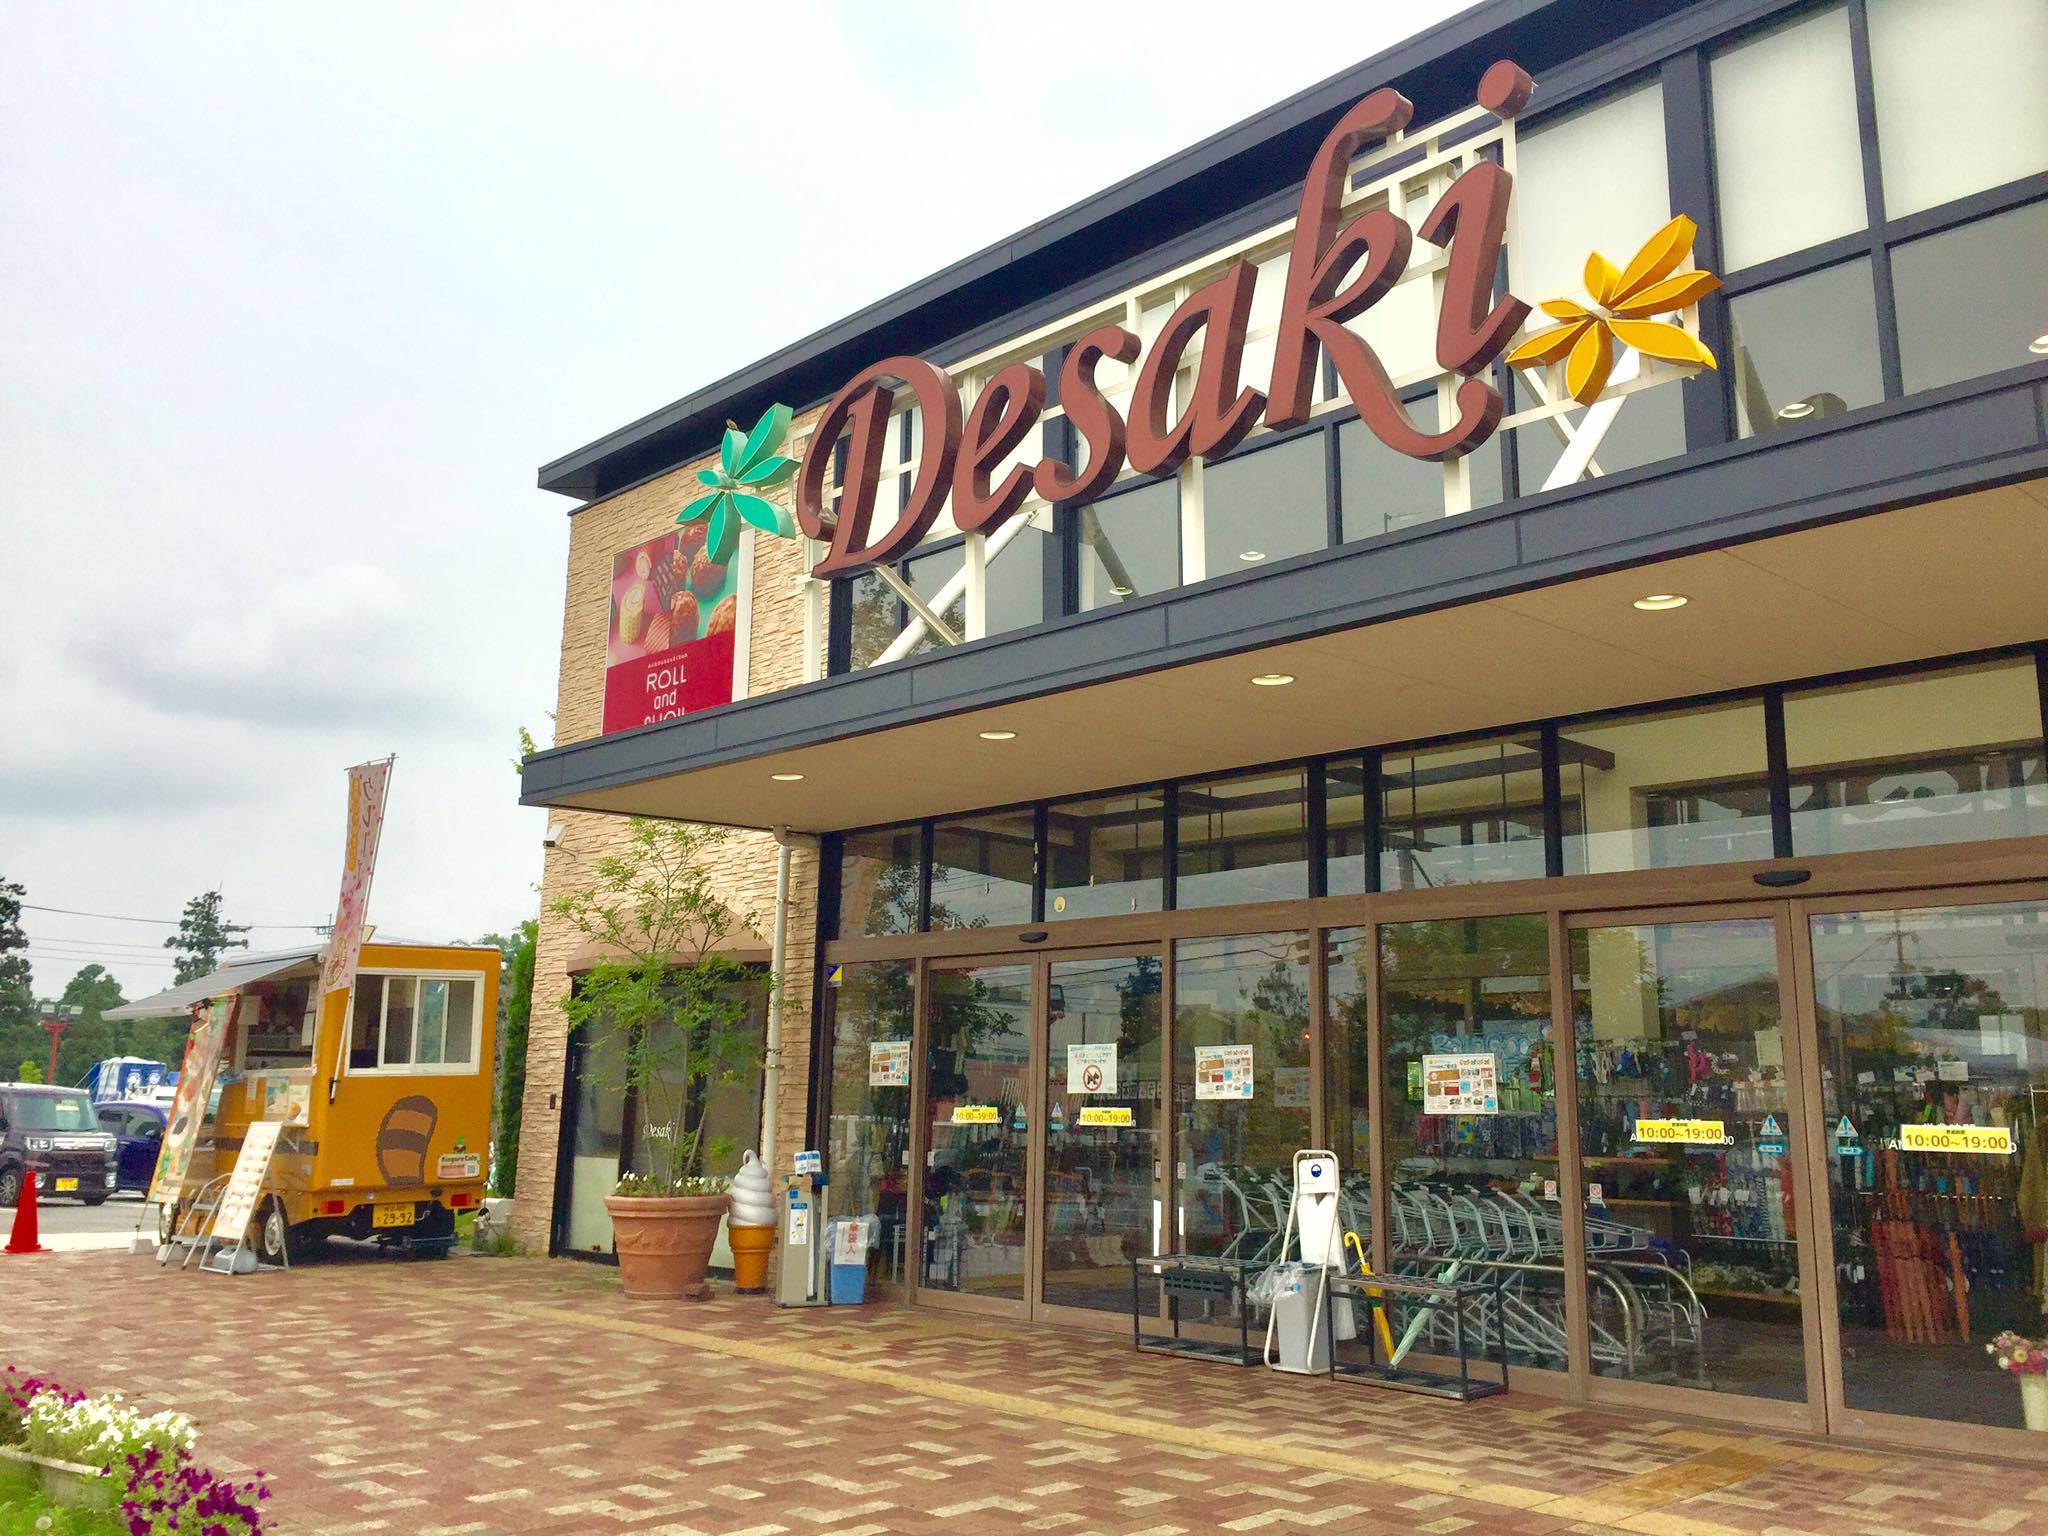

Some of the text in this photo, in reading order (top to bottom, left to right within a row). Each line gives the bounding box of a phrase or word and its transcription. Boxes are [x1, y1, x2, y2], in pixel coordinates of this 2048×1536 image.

[797, 59, 1533, 579] Desaki
[646, 664, 687, 693] ROLL
[654, 689, 677, 710] and
[643, 1120, 675, 1141] Desak
